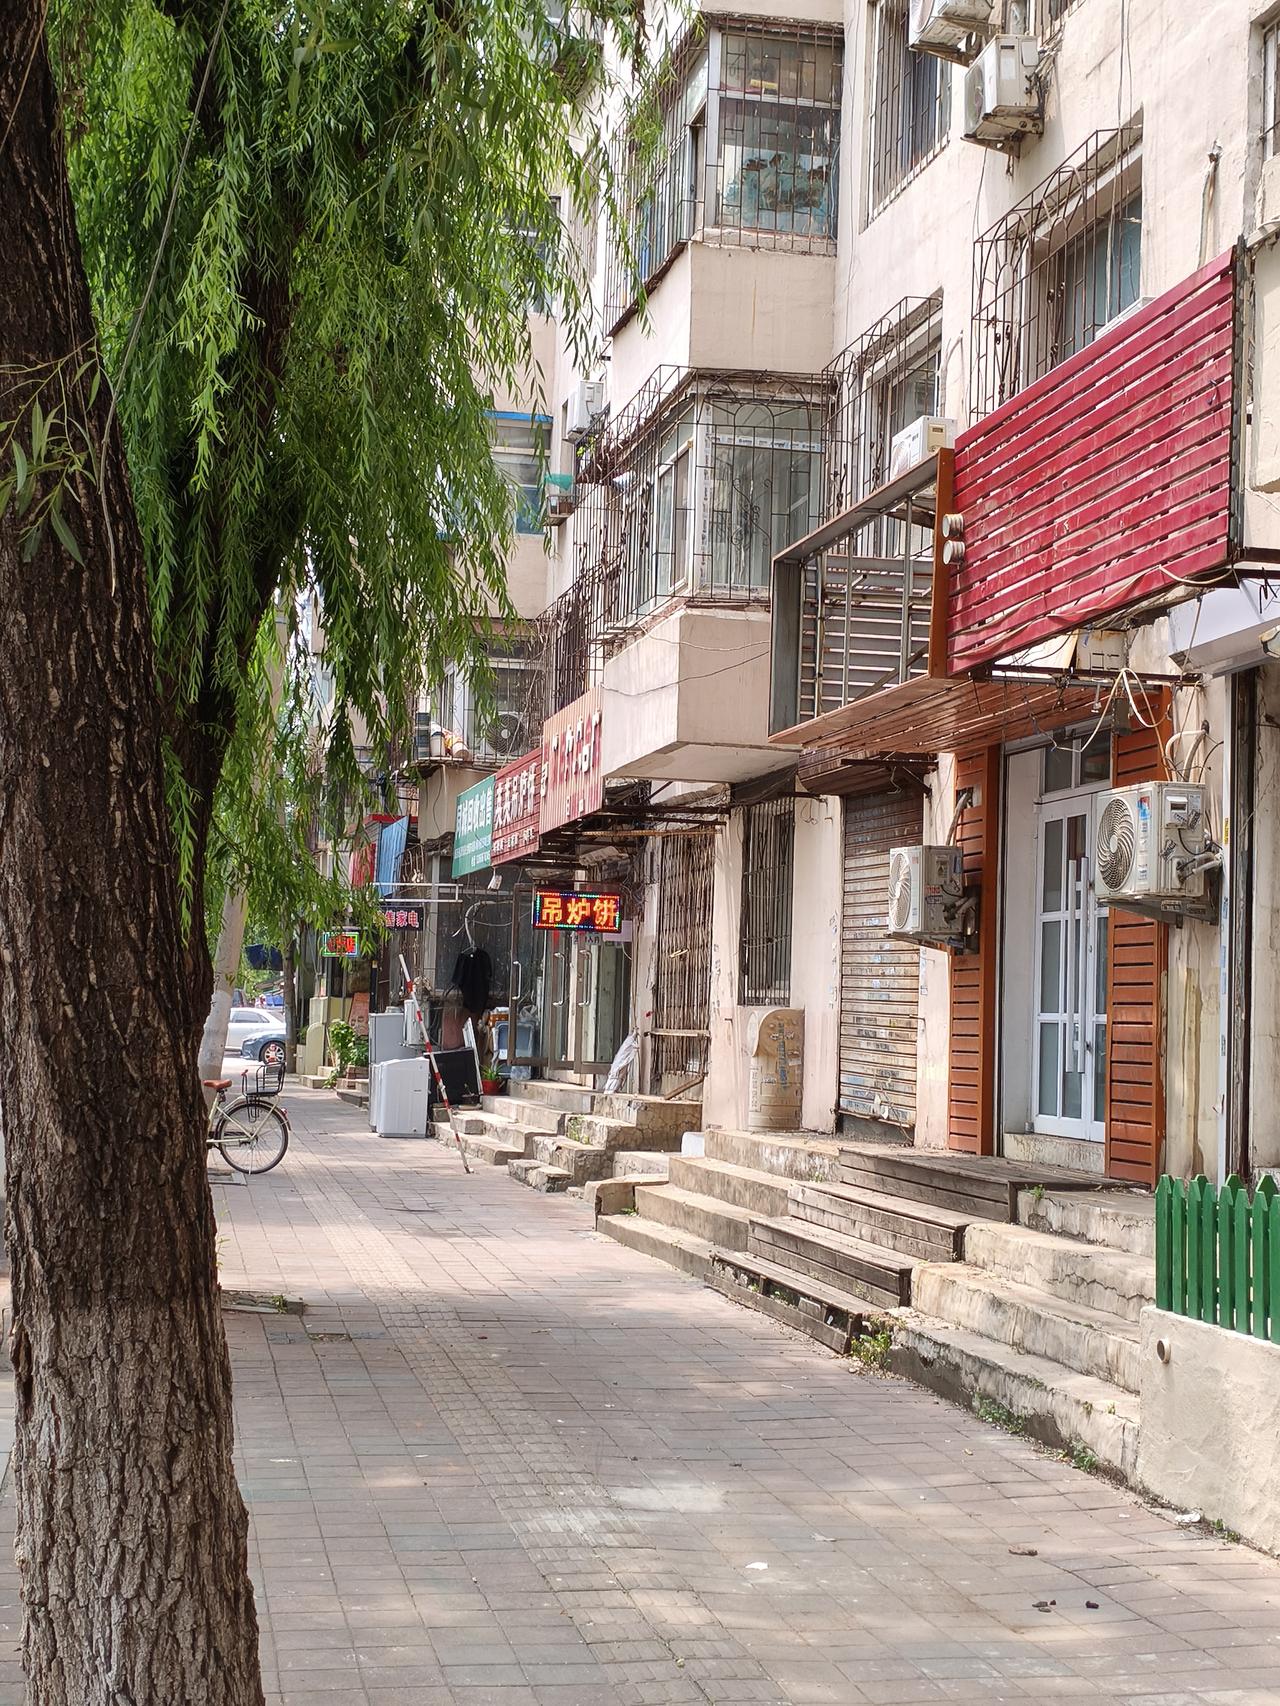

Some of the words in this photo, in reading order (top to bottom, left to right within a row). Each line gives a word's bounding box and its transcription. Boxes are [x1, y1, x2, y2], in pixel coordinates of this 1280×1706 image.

[374, 910, 420, 929] 售家电
[542, 897, 617, 927] 吊炉饼
